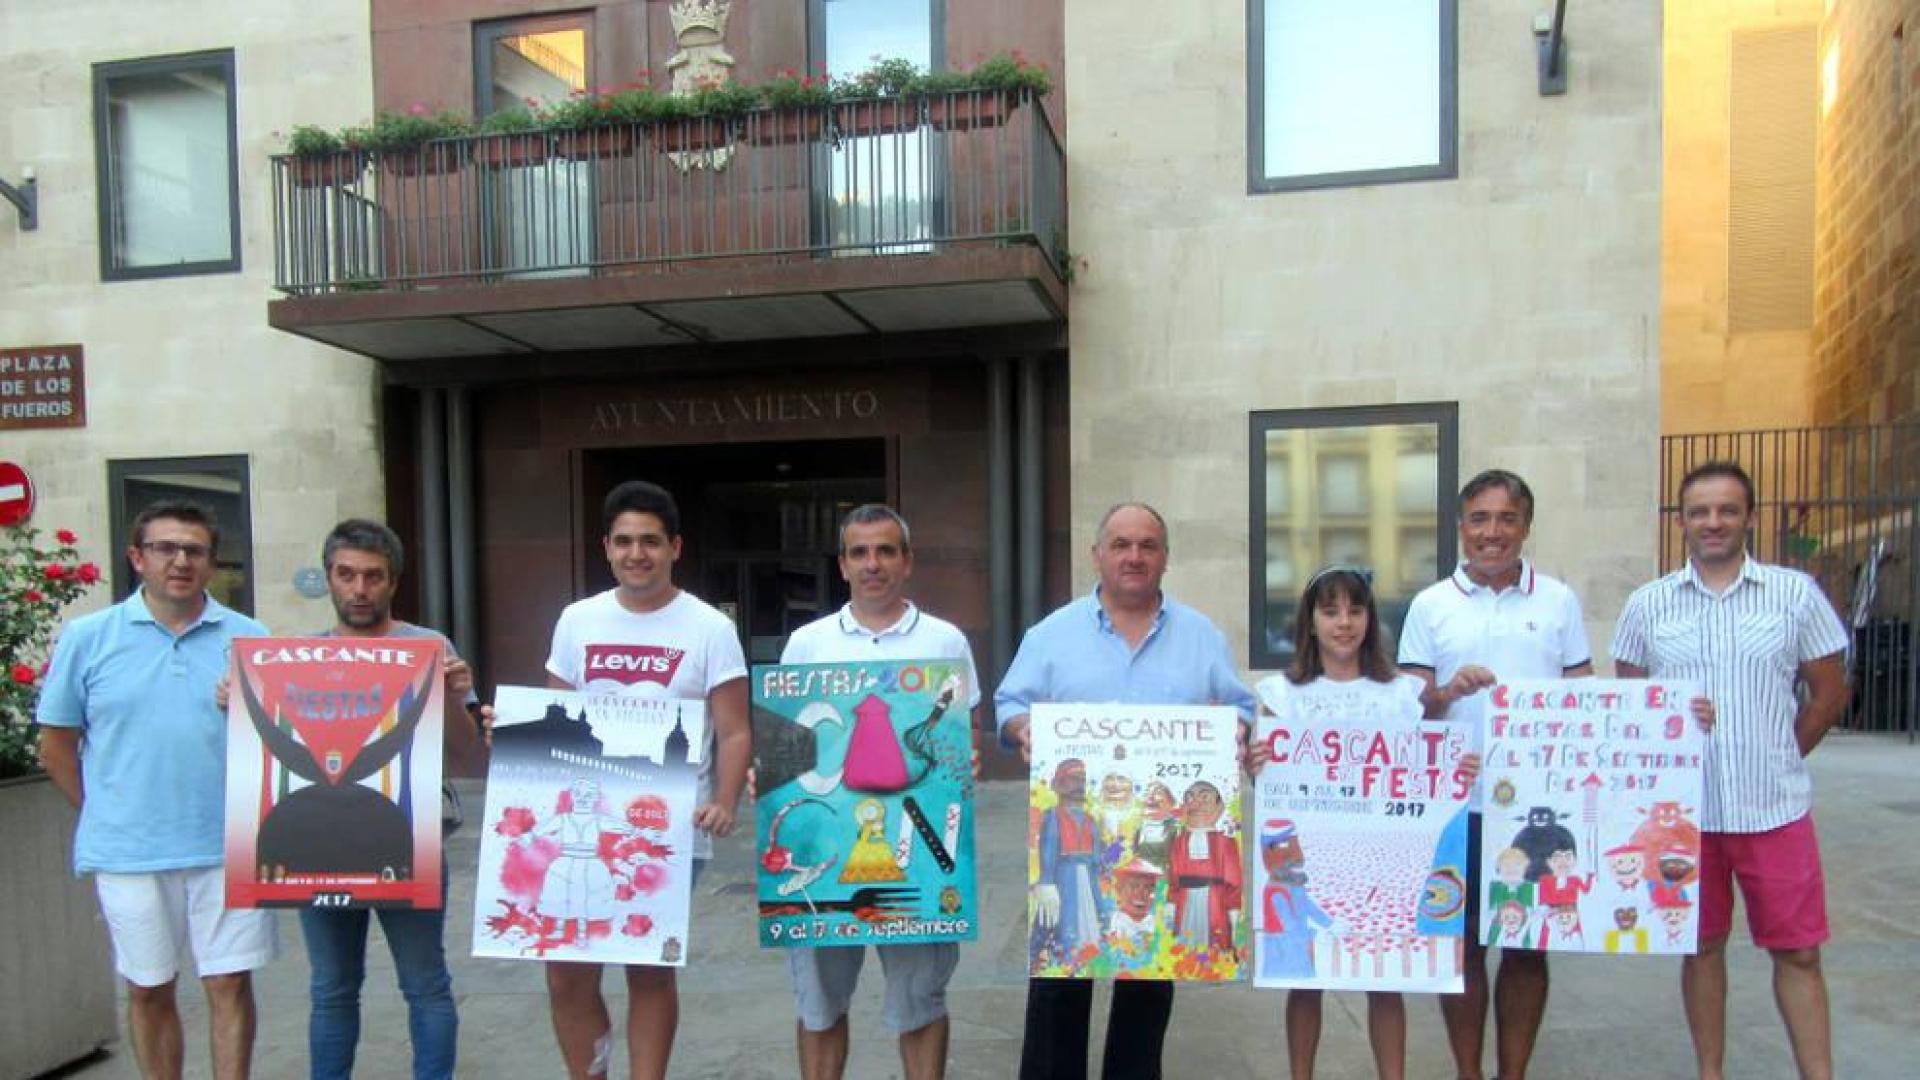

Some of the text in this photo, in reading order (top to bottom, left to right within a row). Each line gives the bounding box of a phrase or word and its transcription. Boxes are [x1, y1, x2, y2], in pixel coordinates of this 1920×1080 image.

[0, 354, 71, 373] PLAZA
[1, 377, 71, 395] DE LOS
[2, 401, 72, 418] FUEROS
[589, 390, 880, 432] AYUNTAMIENTO
[252, 647, 416, 667] CASCANTE
[763, 668, 866, 698] FIESTAS
[1054, 717, 1216, 742] CASCANTE
[1267, 727, 1465, 766] CASCANTE
[1155, 762, 1204, 778] 2017
[1298, 783, 1309, 797] 9
[1339, 786, 1357, 797] 17
[1384, 803, 1426, 818] 2017
[769, 922, 783, 939] 9
[867, 918, 969, 938] septiembre
